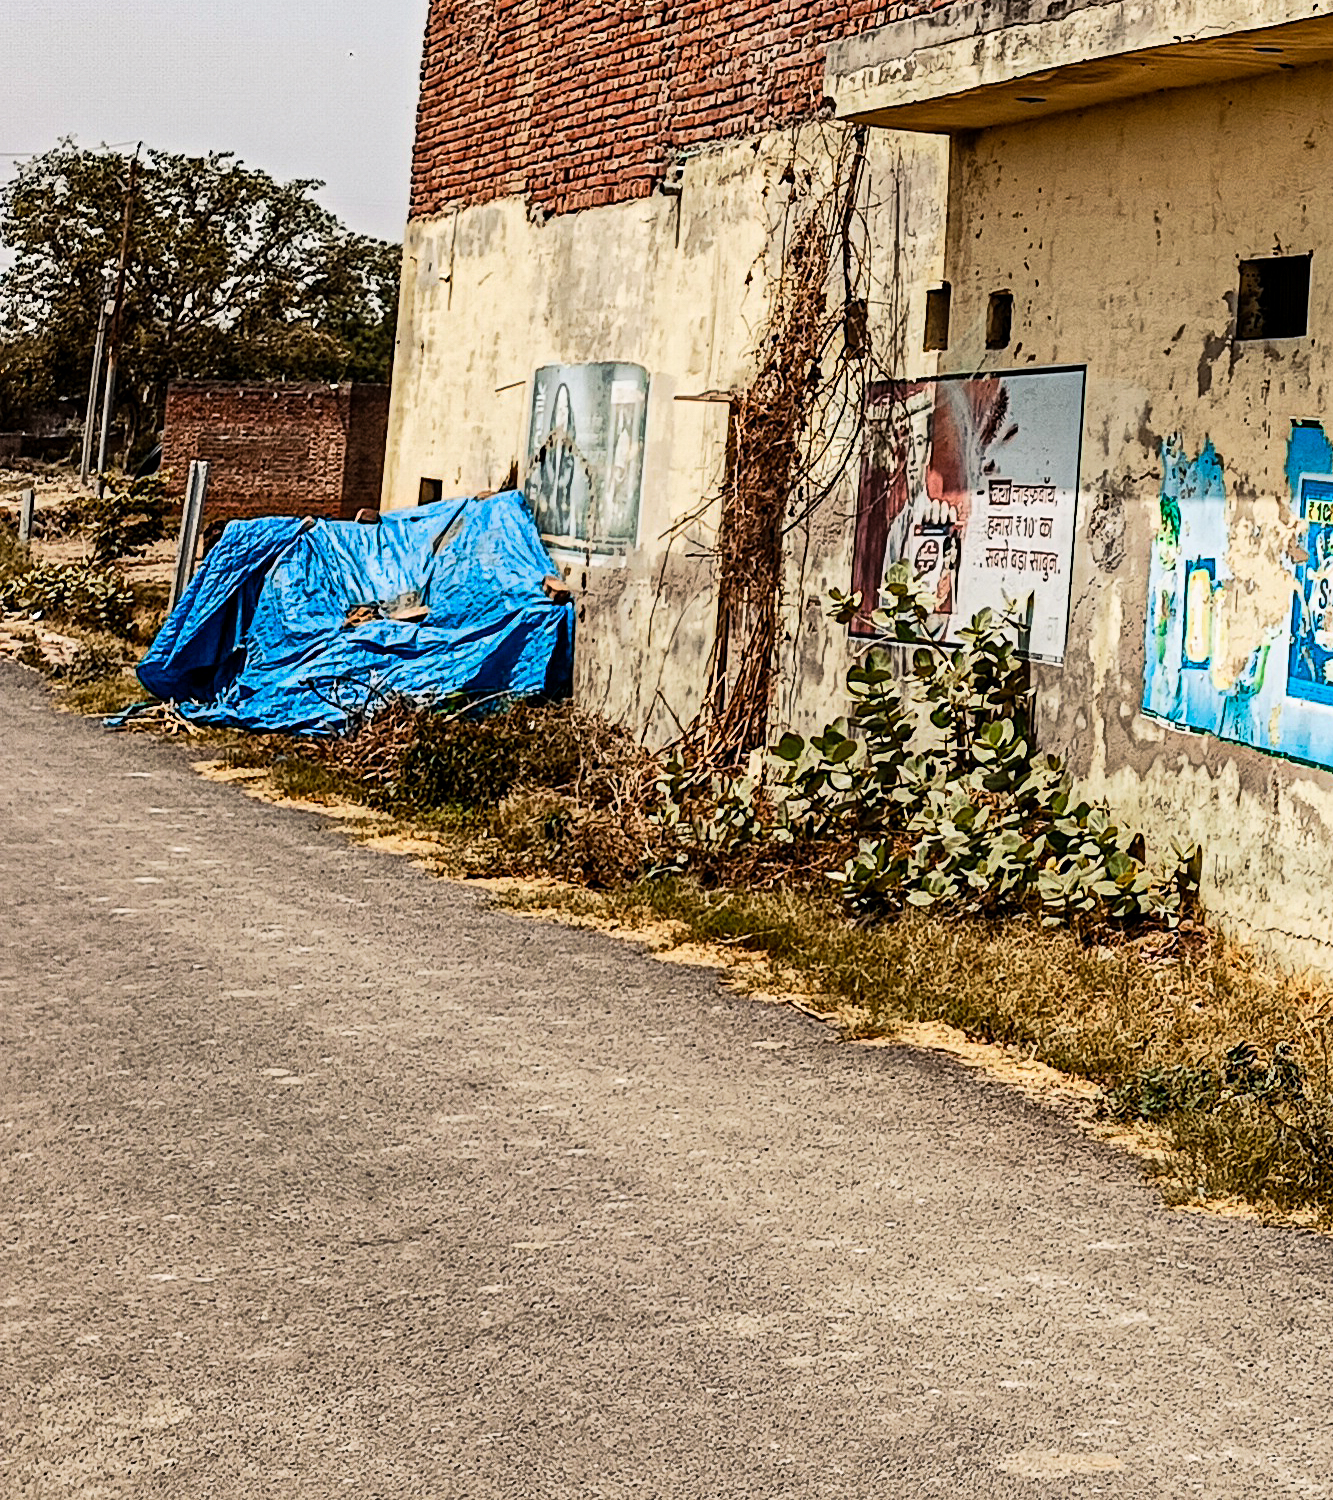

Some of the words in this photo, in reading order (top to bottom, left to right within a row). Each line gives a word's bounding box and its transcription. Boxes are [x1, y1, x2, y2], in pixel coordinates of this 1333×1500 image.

[1040, 517, 1053, 539] का
[986, 539, 1009, 568] सबसे
[1011, 548, 1027, 574] बड़ा
